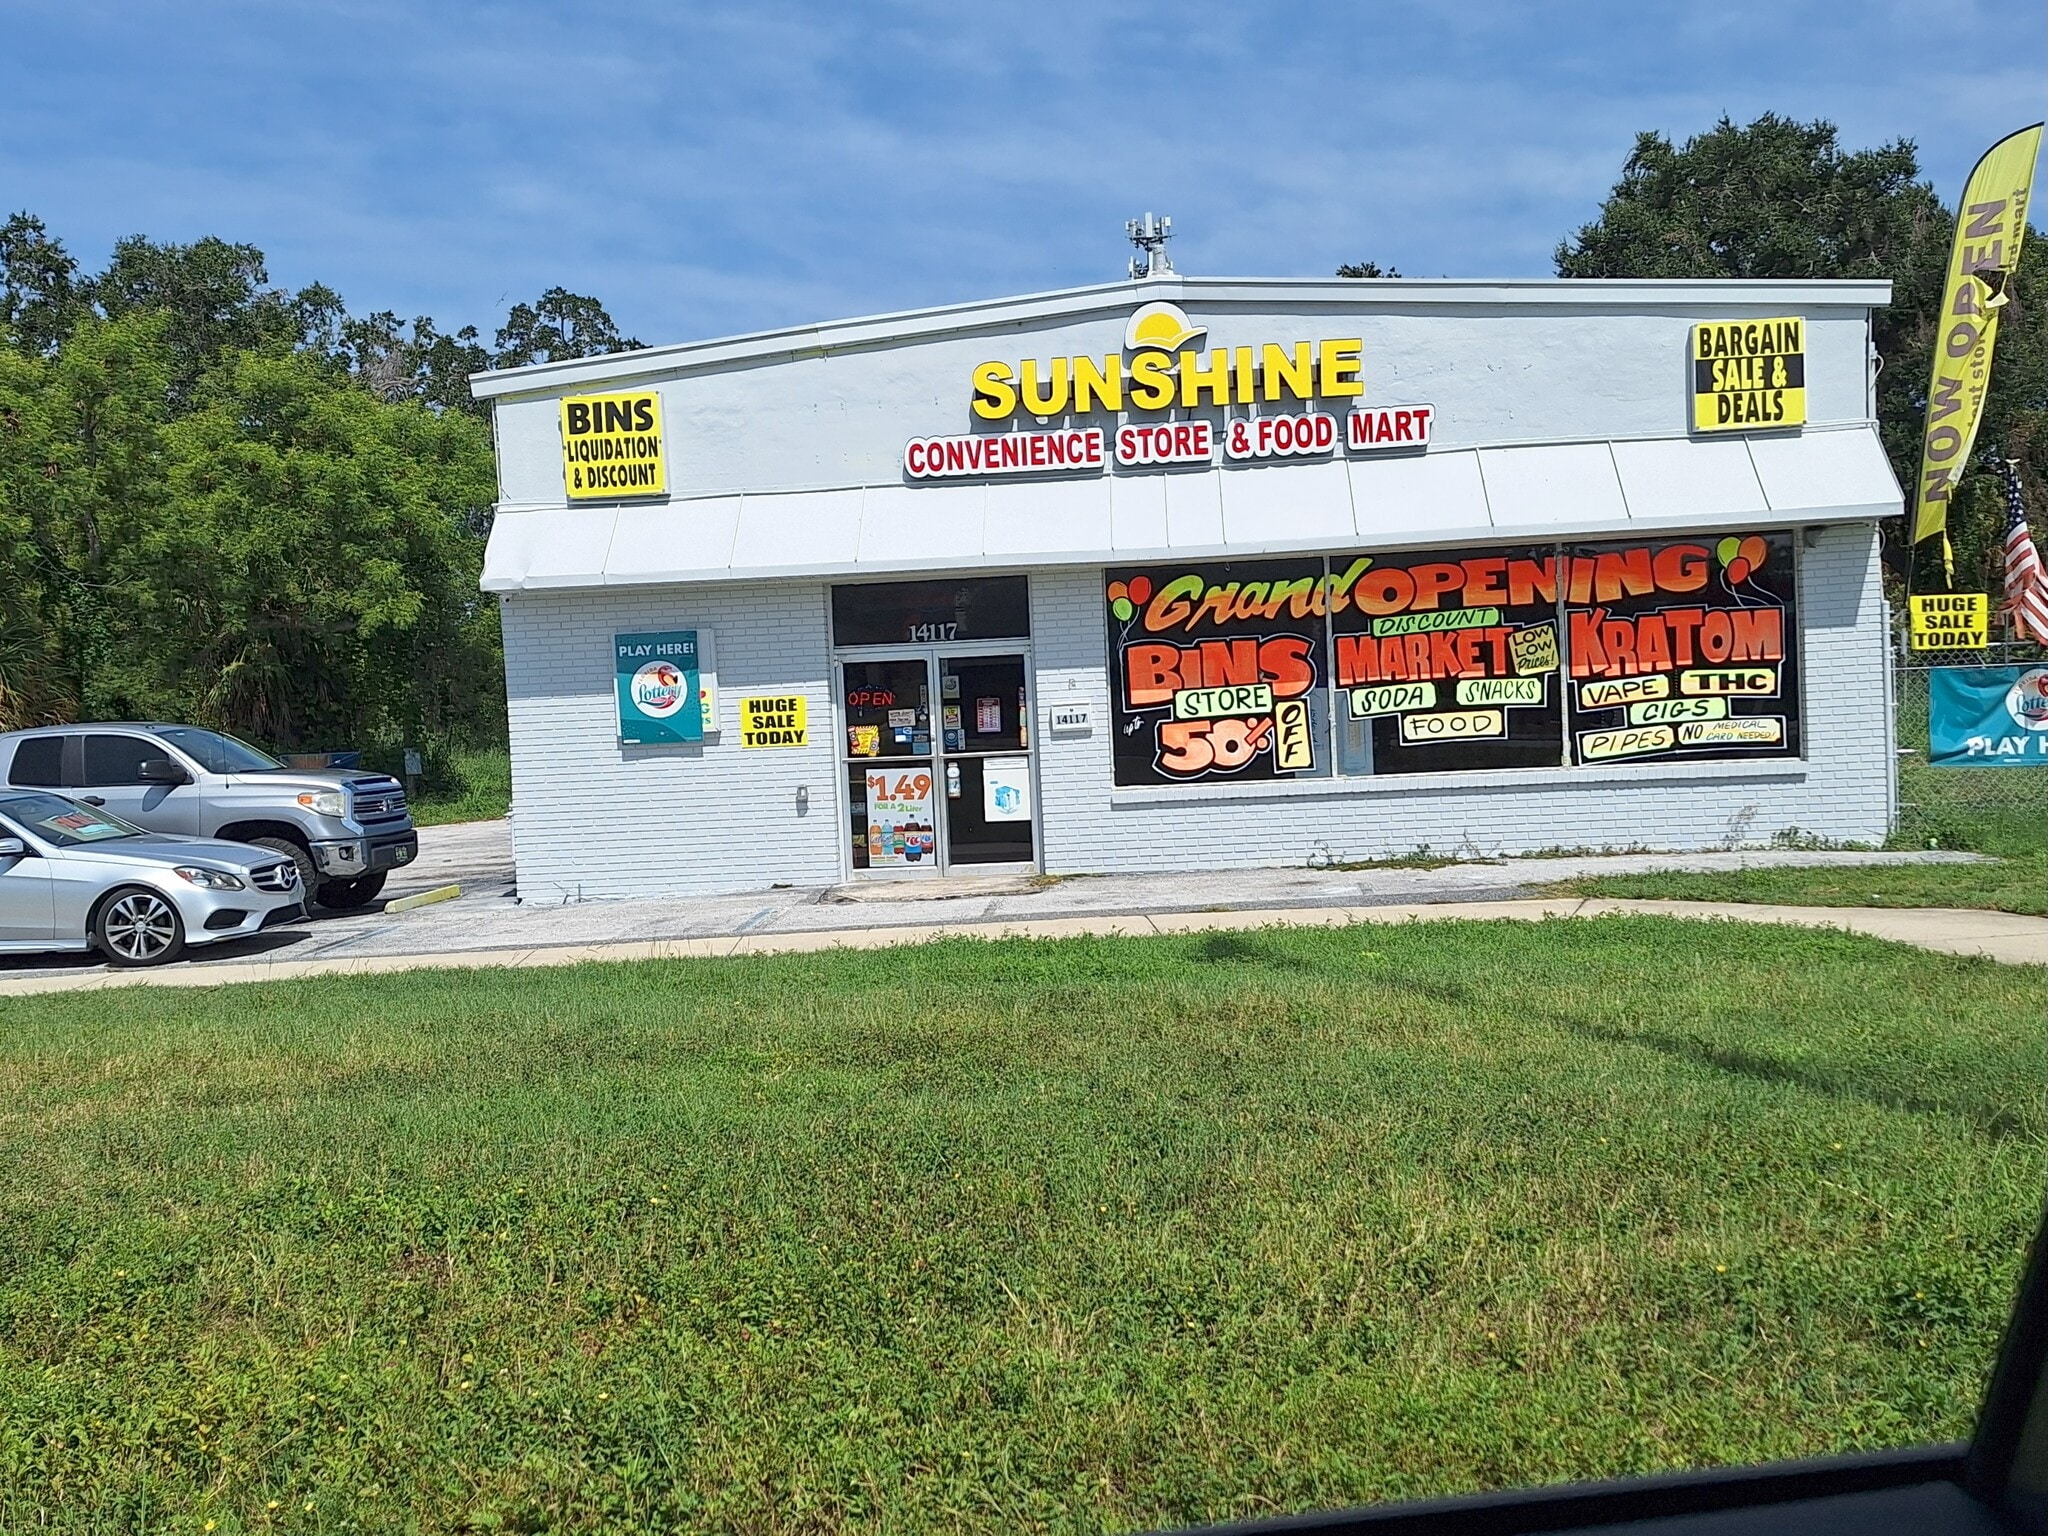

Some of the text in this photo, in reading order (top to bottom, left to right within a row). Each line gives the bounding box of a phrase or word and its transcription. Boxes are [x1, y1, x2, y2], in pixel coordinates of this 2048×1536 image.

[2012, 187, 2027, 239] mart
[1699, 321, 1799, 358] BARGAIN
[1925, 198, 2007, 502] NOW OPEN
[971, 338, 1364, 420] SUNSHINE
[1712, 356, 1787, 392] SALE &
[567, 398, 654, 435] BINS
[1717, 390, 1784, 424] DEALS
[567, 435, 659, 463] LIQUIDATION
[908, 409, 1430, 475] CONVENIENCE STORE & FOOD MART
[574, 462, 656, 489] & DISCOUNT
[1144, 543, 1710, 632] Grand OPENING
[1921, 597, 1977, 612] HUGE
[909, 622, 958, 642] 14117
[1379, 608, 1494, 634] DISCOUNT
[1925, 614, 1973, 629] SALE
[618, 642, 695, 657] PLAY HERE!
[1512, 626, 1550, 647] LOW
[1515, 638, 1552, 659] LOW
[1570, 607, 1782, 677] KRATOM
[1914, 631, 1984, 647] TODAY
[1338, 626, 1514, 686] MARKET
[1516, 650, 1555, 672] Prices!
[1128, 638, 1312, 705] BINS
[637, 683, 682, 706] Lottery
[848, 691, 893, 706] OPEN
[1184, 685, 1267, 716] STORE
[1361, 680, 1536, 713] SODA SNACKS
[1587, 673, 1767, 704] VAPE THC
[749, 698, 798, 714] HUGE
[1056, 713, 1087, 725] 14117
[1642, 699, 1710, 722] CIGS
[752, 714, 796, 729] SALE
[1281, 704, 1303, 763] OFF
[1409, 715, 1491, 736] FOOD
[1712, 719, 1767, 730] MEDICAL
[744, 730, 805, 745] TODAY
[1161, 716, 1273, 772] 50%
[1590, 724, 1703, 754] PIPES NO
[1706, 731, 1776, 741] CARD NEEDED!
[1966, 735, 2032, 756] PLAY
[867, 773, 931, 801] $1.49
[897, 803, 905, 812] 2
